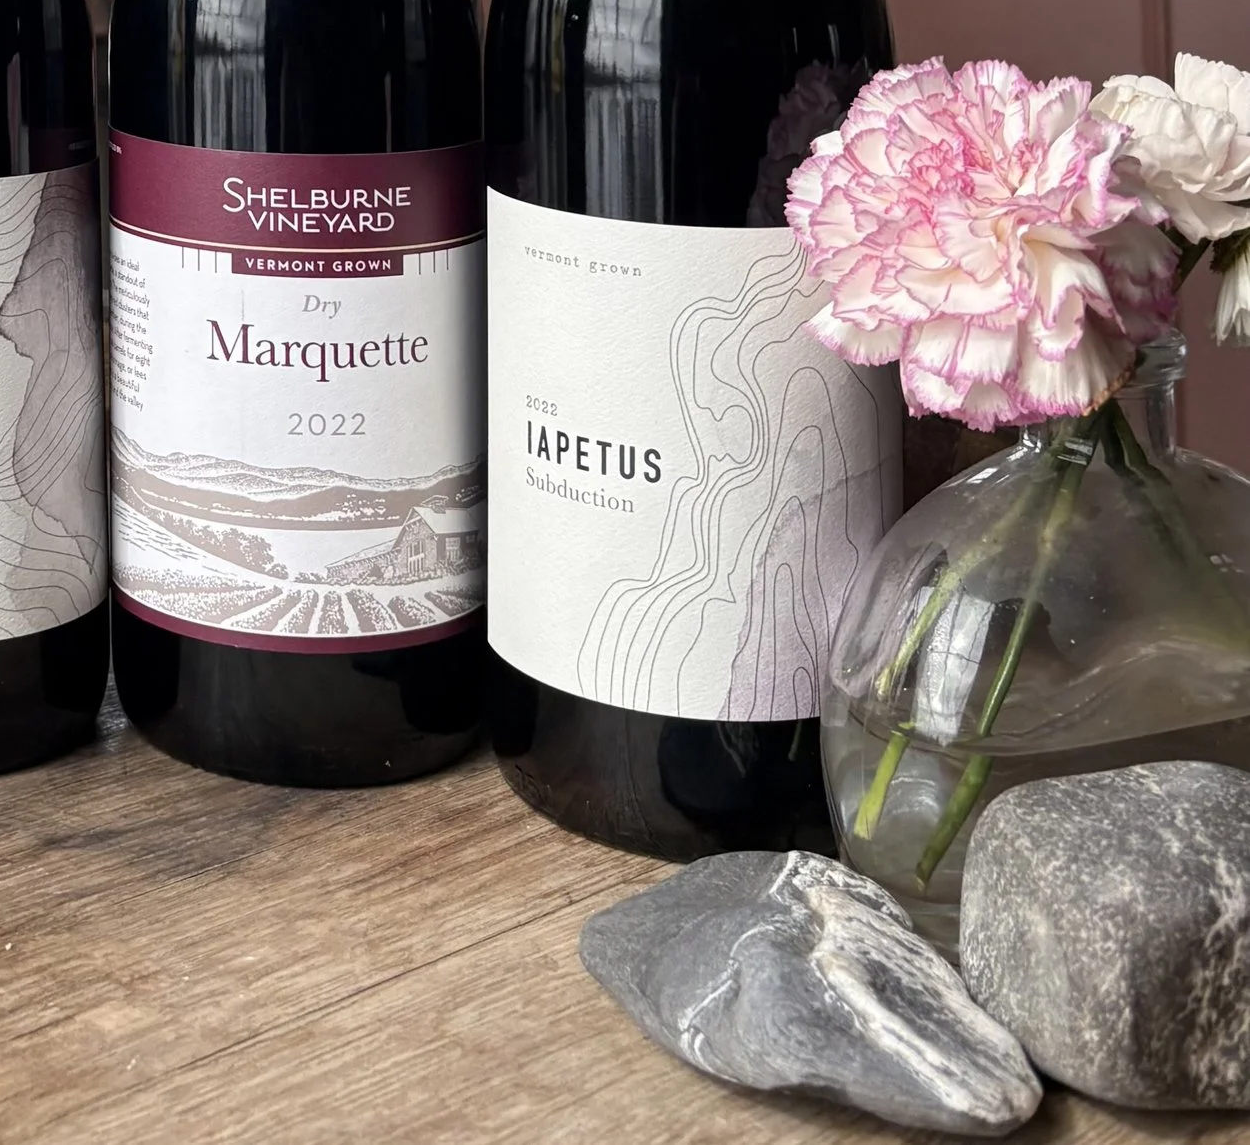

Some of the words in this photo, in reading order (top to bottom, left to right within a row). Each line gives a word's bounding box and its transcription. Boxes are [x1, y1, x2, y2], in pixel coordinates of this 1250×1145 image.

[222, 177, 411, 213] SHELBURNE
[248, 209, 395, 233] VINEYARD
[245, 257, 325, 272] VERMONT
[332, 258, 392, 272] GROWN
[524, 245, 580, 268] vermont
[588, 259, 642, 277] grown
[302, 294, 342, 319] Dry
[206, 319, 429, 383] Marquette
[526, 394, 558, 417] 2022
[287, 412, 367, 437] 2022
[527, 420, 662, 484] IAPETUS
[525, 466, 635, 514] Subduction
